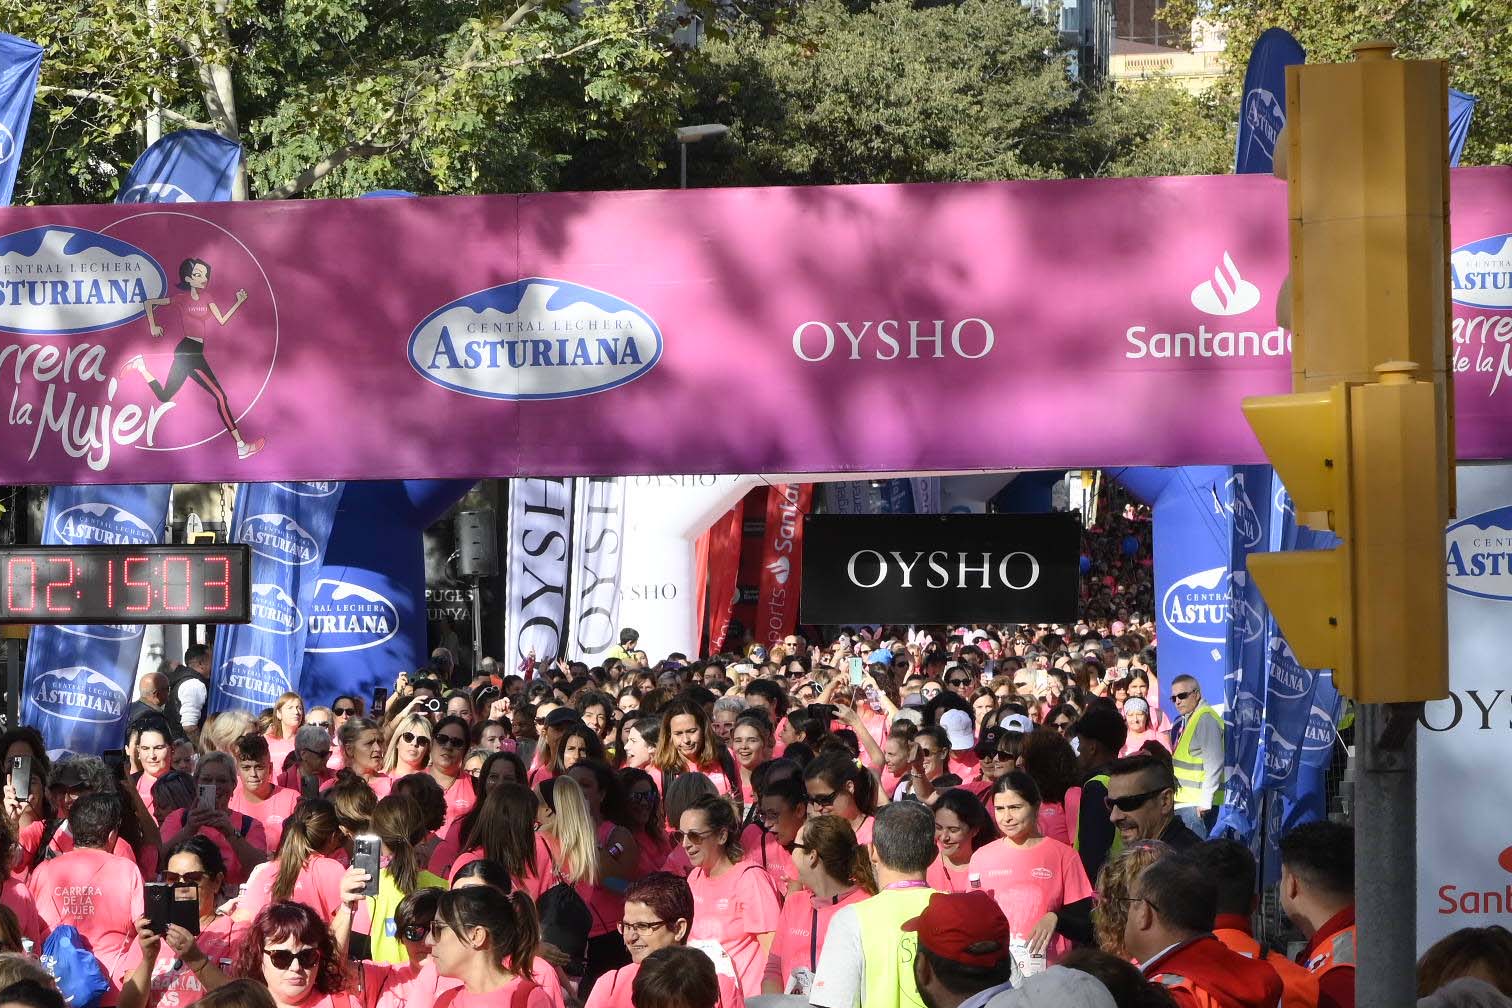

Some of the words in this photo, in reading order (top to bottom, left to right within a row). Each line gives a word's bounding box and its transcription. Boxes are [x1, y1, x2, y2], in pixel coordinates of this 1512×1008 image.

[70, 261, 142, 272] LECHERA
[1465, 260, 1512, 268] CENTRA
[467, 320, 545, 334] CENTRAL
[551, 319, 634, 332] LECHERA
[792, 317, 995, 362] OYSHO
[1126, 325, 1292, 359] Santand
[426, 325, 643, 370] ASTURIANA
[8, 385, 33, 425] la
[28, 377, 176, 472] Mujer
[775, 483, 800, 553] Santa
[518, 477, 567, 669] OYSH
[577, 477, 619, 654] OYSH
[846, 550, 1040, 592] OYSHO
[8, 556, 230, 612] 02:15:03
[1186, 593, 1228, 601] CENTRA
[309, 615, 389, 634] URIANA
[337, 604, 385, 612] LECHERA
[35, 682, 122, 716] ASTURIANA
[221, 673, 286, 698] ASTURIAN
[54, 886, 103, 896] CARRERA
[62, 906, 95, 915] MUJER
